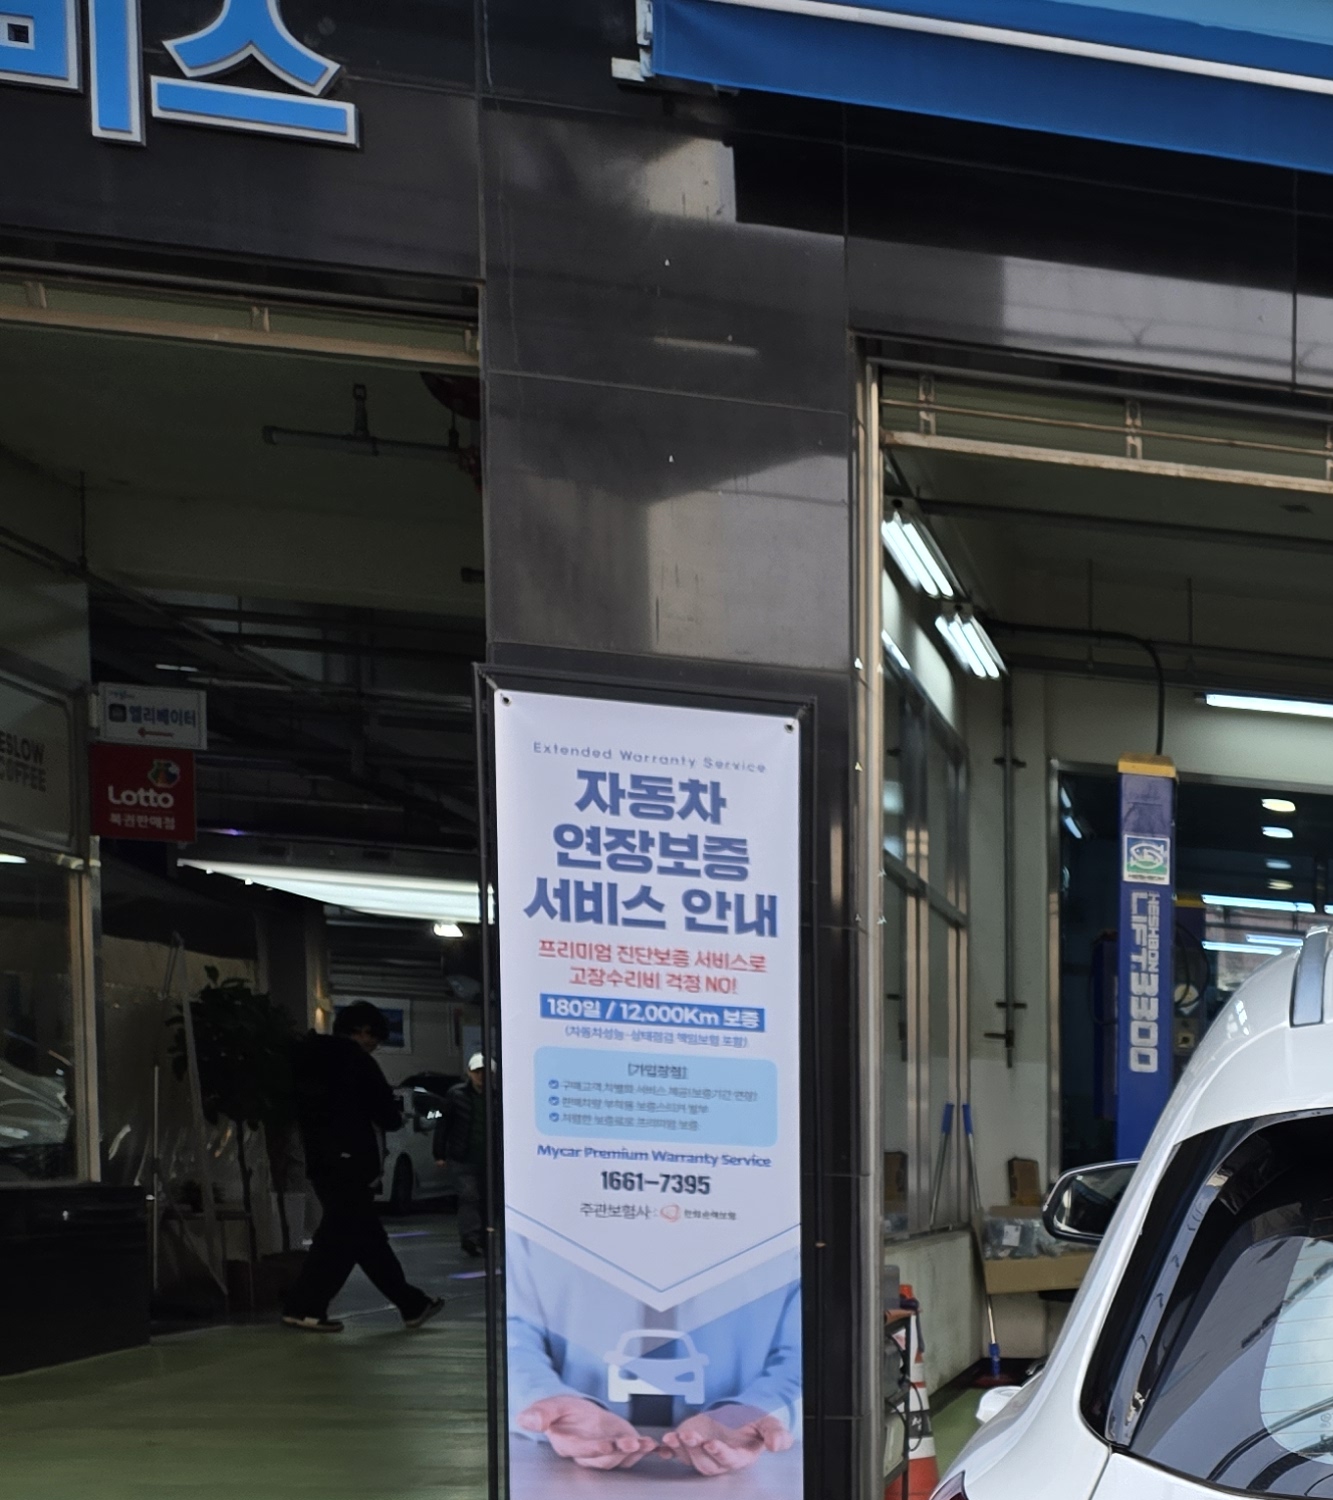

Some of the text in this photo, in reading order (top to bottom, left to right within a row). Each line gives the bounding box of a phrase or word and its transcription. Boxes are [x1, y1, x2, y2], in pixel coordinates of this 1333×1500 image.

[533, 741, 767, 774] Extended Warranty Service
[107, 785, 175, 809] Lotto
[575, 769, 727, 825] 자동차
[553, 823, 751, 882] 연장보증
[523, 876, 779, 938] 서비스 안내
[1147, 891, 1160, 972] HESHBON
[538, 939, 768, 974] 프리미엄 진단보증 서비스로
[569, 966, 739, 995] 고장수리비 걱정 NO!
[547, 998, 600, 1018] 180일
[620, 1002, 719, 1027] 12,000Km
[723, 1008, 762, 1029] 보증
[537, 1144, 772, 1168] Mycar Premium Warranty Service
[600, 1170, 711, 1195] 1661-7395
